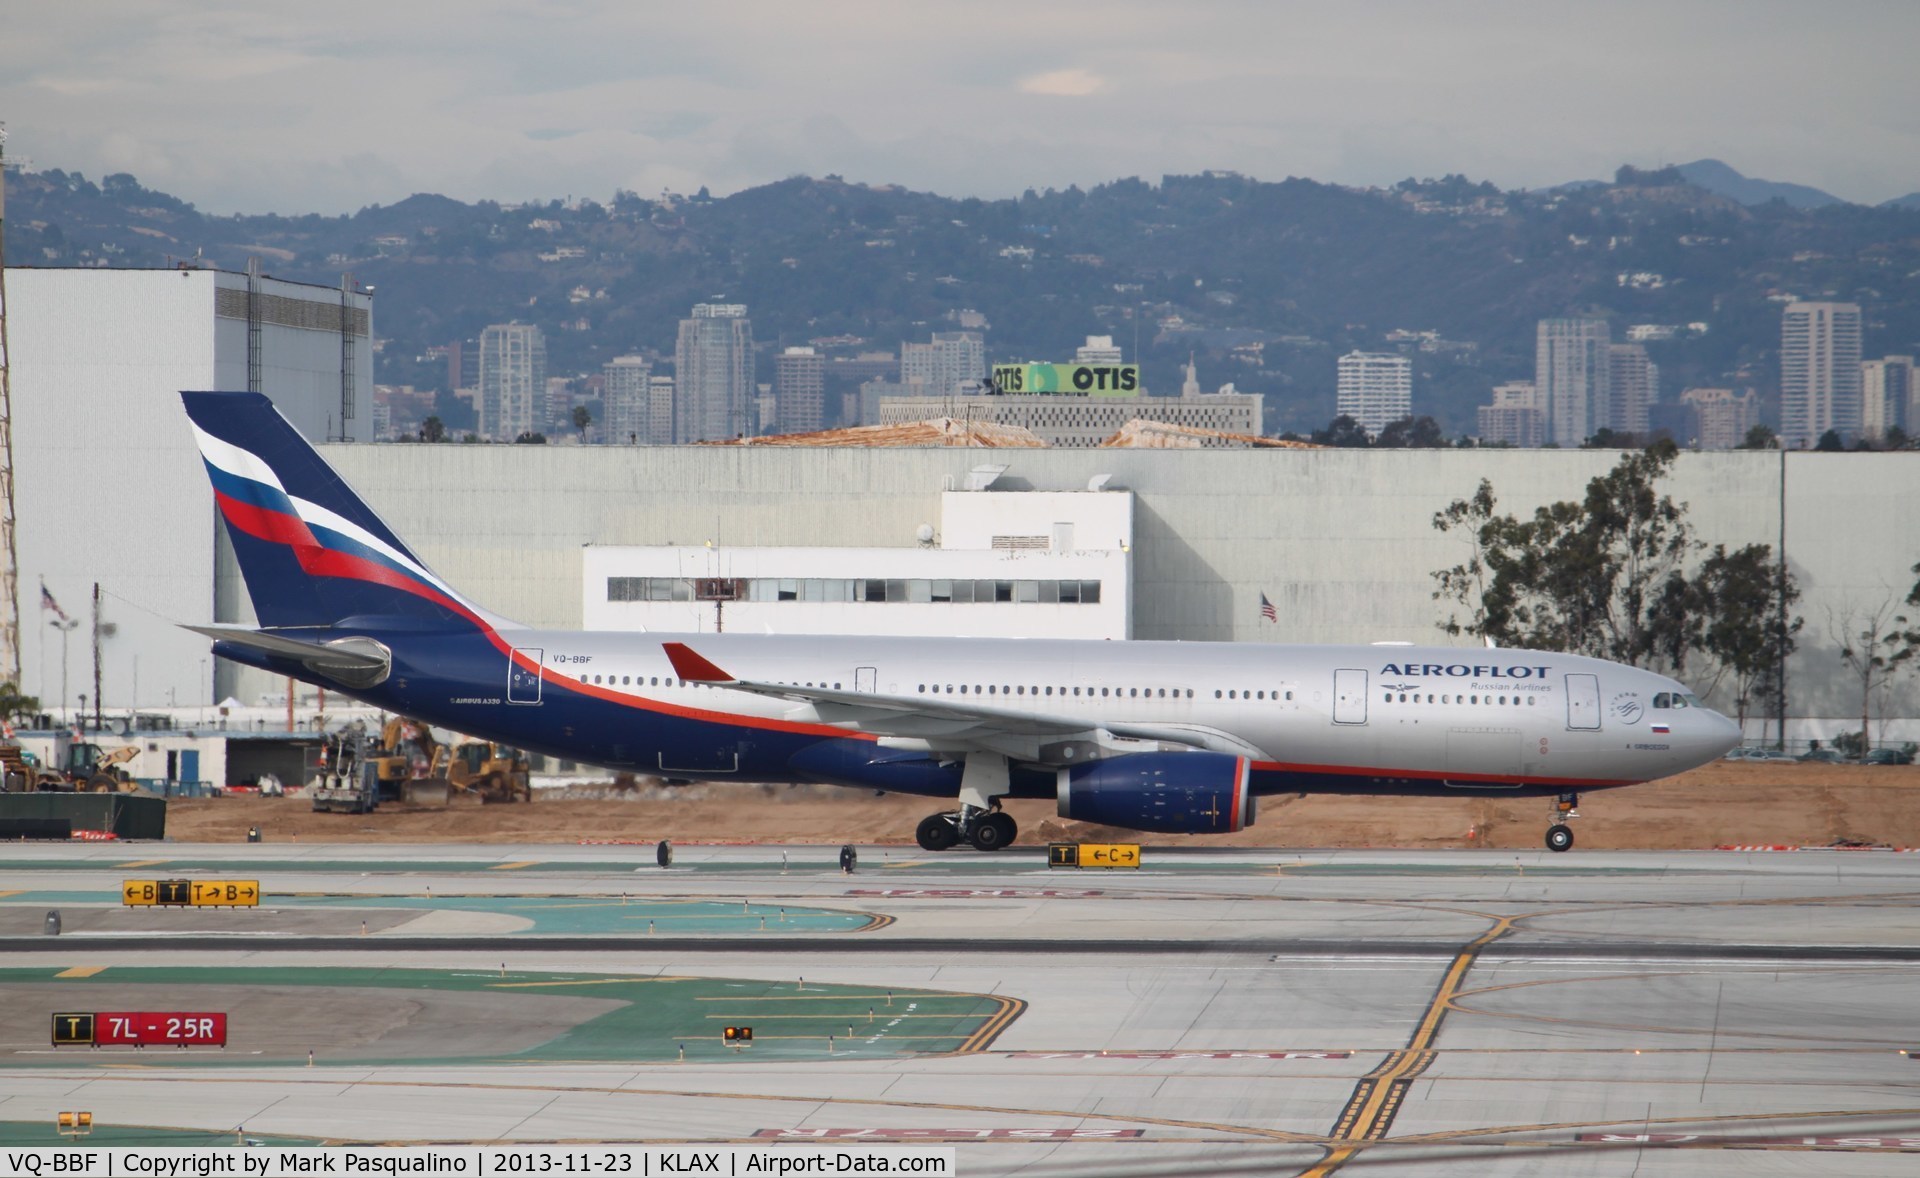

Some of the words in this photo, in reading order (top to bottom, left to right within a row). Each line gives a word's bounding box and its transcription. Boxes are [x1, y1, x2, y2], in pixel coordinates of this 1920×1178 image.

[993, 367, 1022, 390] OTIS
[1072, 367, 1136, 391] OTIS
[553, 654, 592, 664] VQ-BBF
[1380, 663, 1552, 679] AEROFLOT
[1470, 682, 1510, 691] Russian
[1512, 683, 1552, 692] Airlines
[1058, 848, 1069, 862] T
[1110, 848, 1118, 862] C
[143, 885, 154, 900] B
[169, 884, 179, 900] T
[193, 885, 203, 900] T
[226, 885, 237, 900] B
[67, 1018, 81, 1038] T
[108, 1018, 138, 1038] 7L
[166, 1018, 214, 1038] 25R
